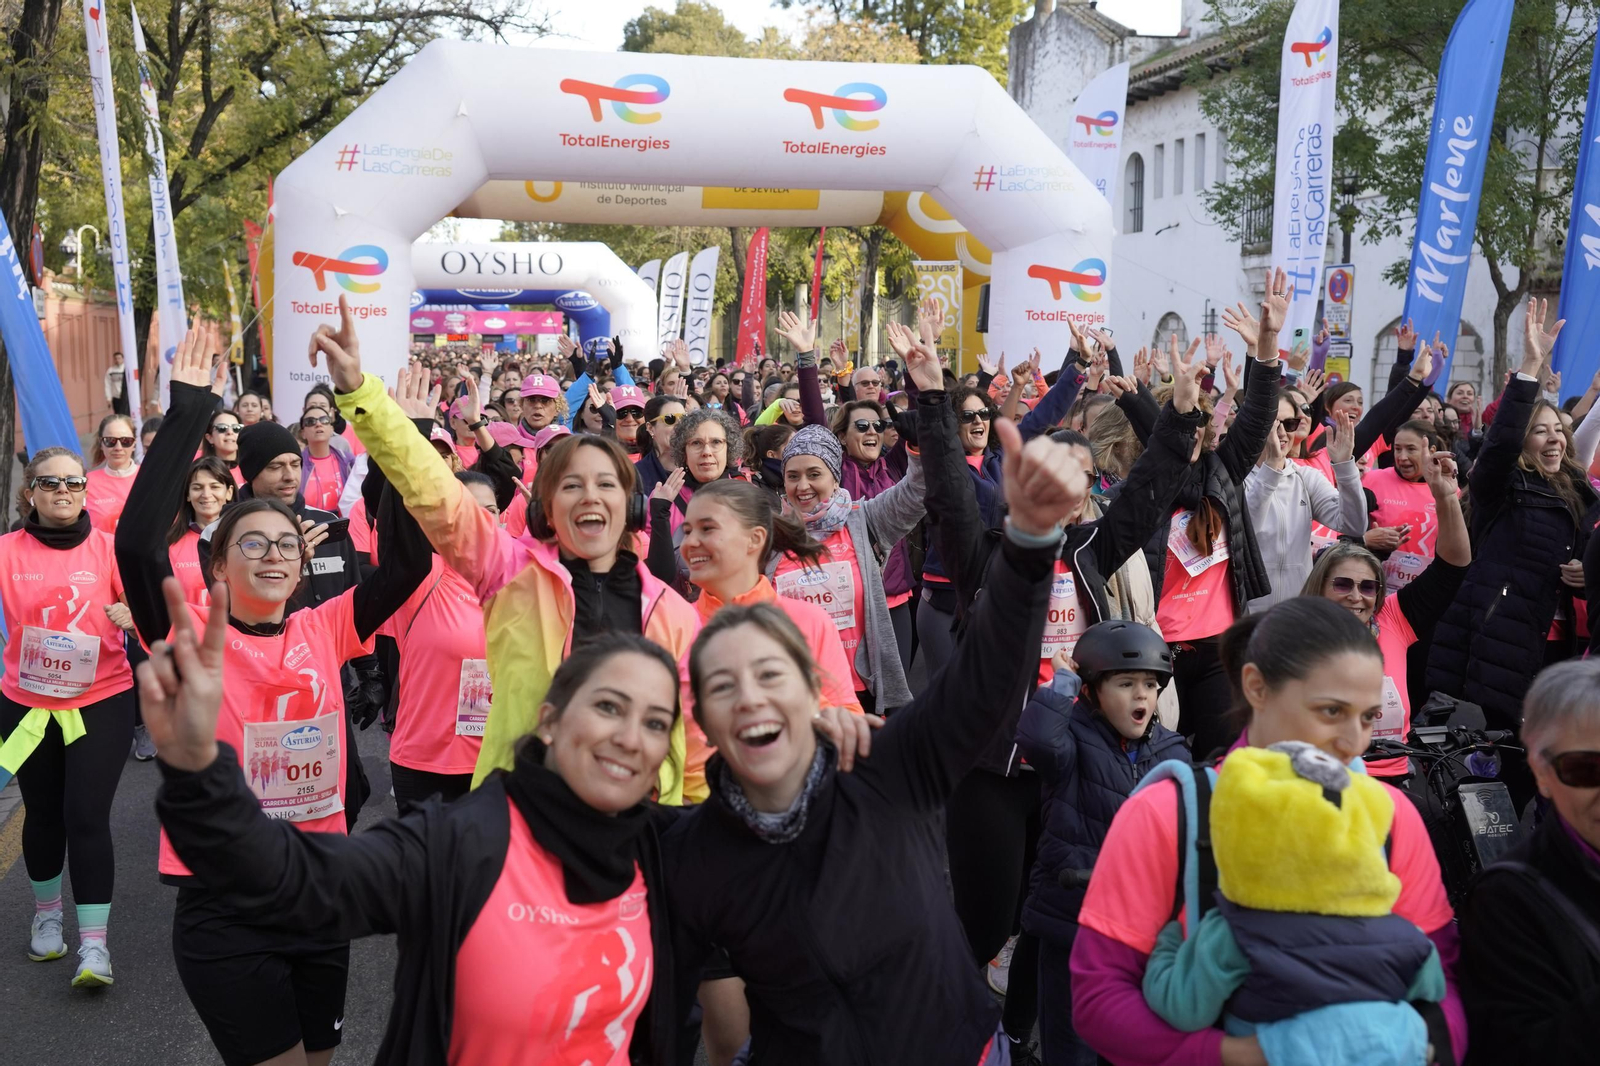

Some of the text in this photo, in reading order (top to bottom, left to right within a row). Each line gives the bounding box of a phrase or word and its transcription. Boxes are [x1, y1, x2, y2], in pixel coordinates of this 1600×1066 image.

[559, 133, 670, 152] TotalEnergies
[782, 141, 887, 158] TotalEnergies
[1073, 141, 1117, 150] TotalEnergies
[362, 158, 452, 177] LasCarreras
[596, 195, 667, 206] de Deportes
[1415, 114, 1478, 304] Marlene
[441, 250, 563, 276] OYSHO
[689, 273, 712, 365] OYSHO
[1025, 310, 1105, 325] TotalEnergies
[533, 376, 544, 387] R
[621, 385, 636, 397] M
[12, 573, 44, 581] OYSHO
[1048, 609, 1075, 623] 016
[45, 639, 74, 649] ASTURIANA
[43, 657, 72, 671] 016
[25, 681, 45, 691] OYSHO
[286, 760, 322, 782] 016
[297, 785, 315, 795] 2155
[267, 810, 296, 819] YSHO
